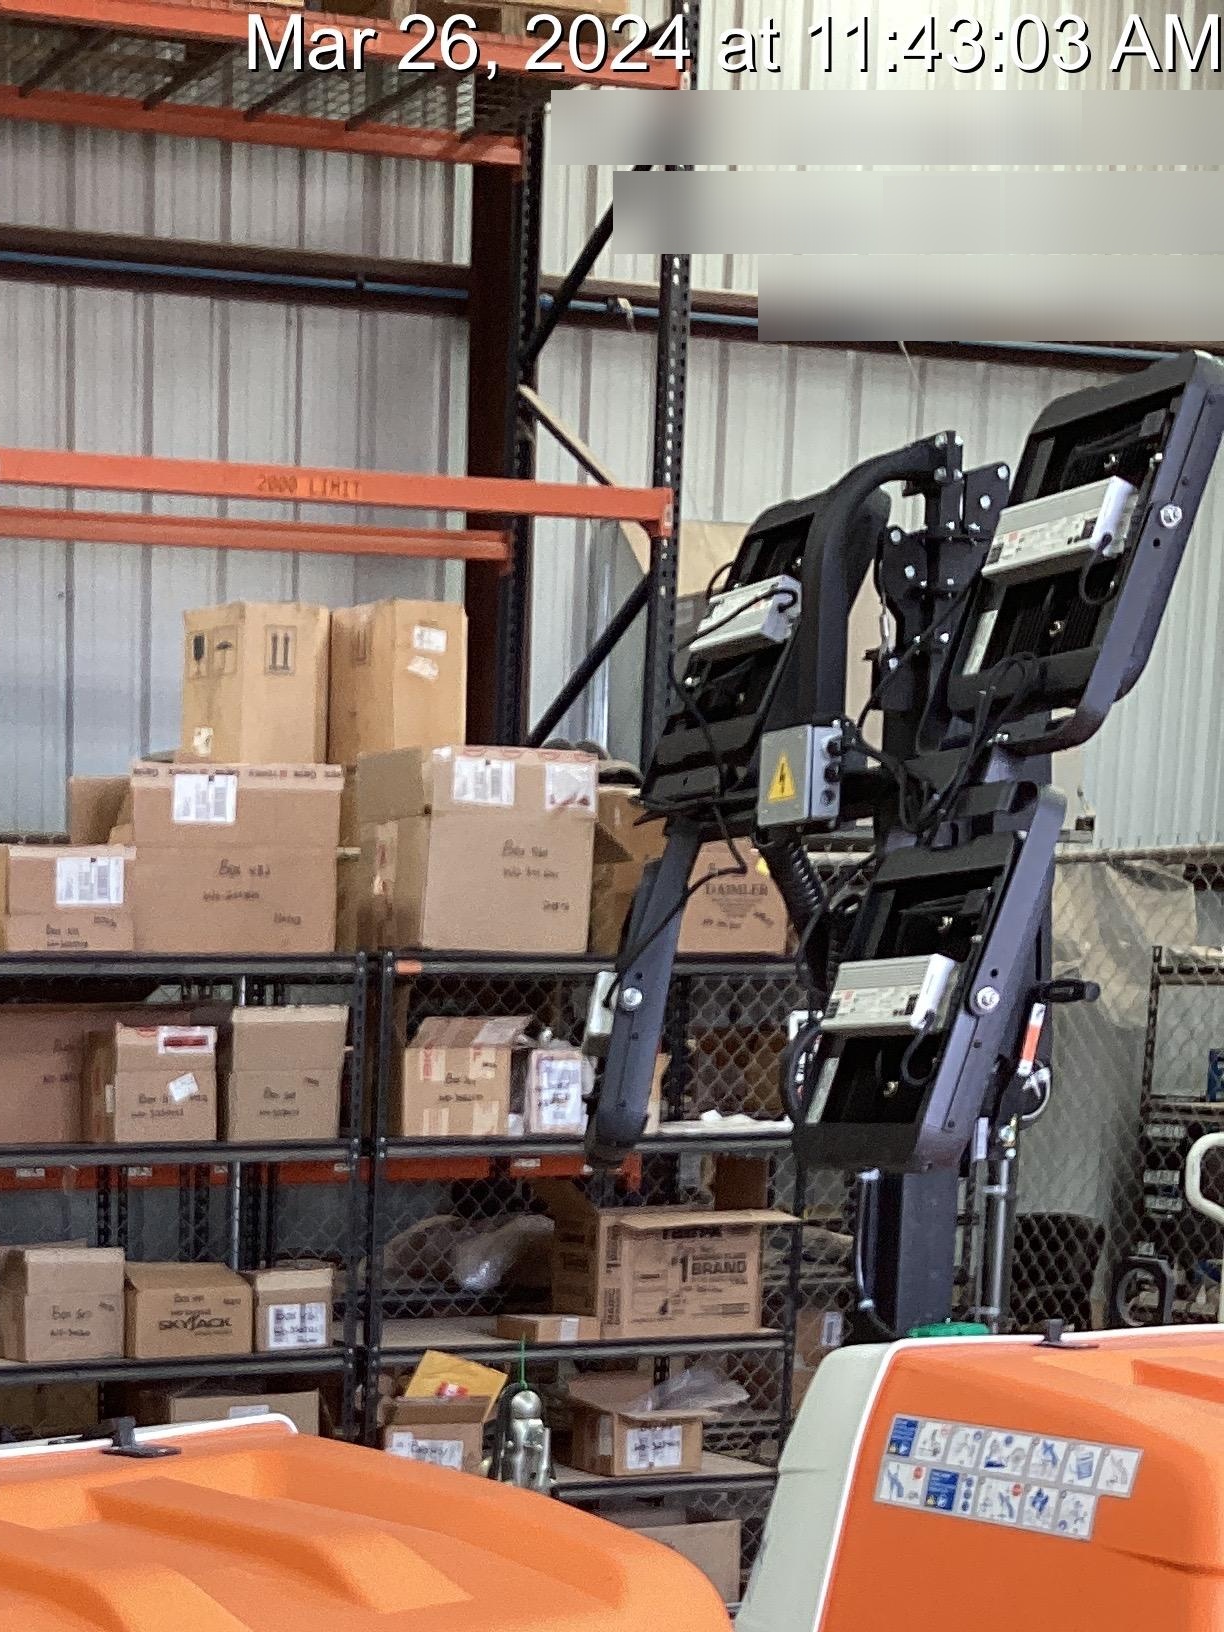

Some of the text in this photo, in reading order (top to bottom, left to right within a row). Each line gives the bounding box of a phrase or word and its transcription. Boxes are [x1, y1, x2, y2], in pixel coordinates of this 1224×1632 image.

[309, 477, 360, 498] LIMIT
[692, 1260, 747, 1275] BRAND
[159, 1312, 233, 1331] SKYJACK
